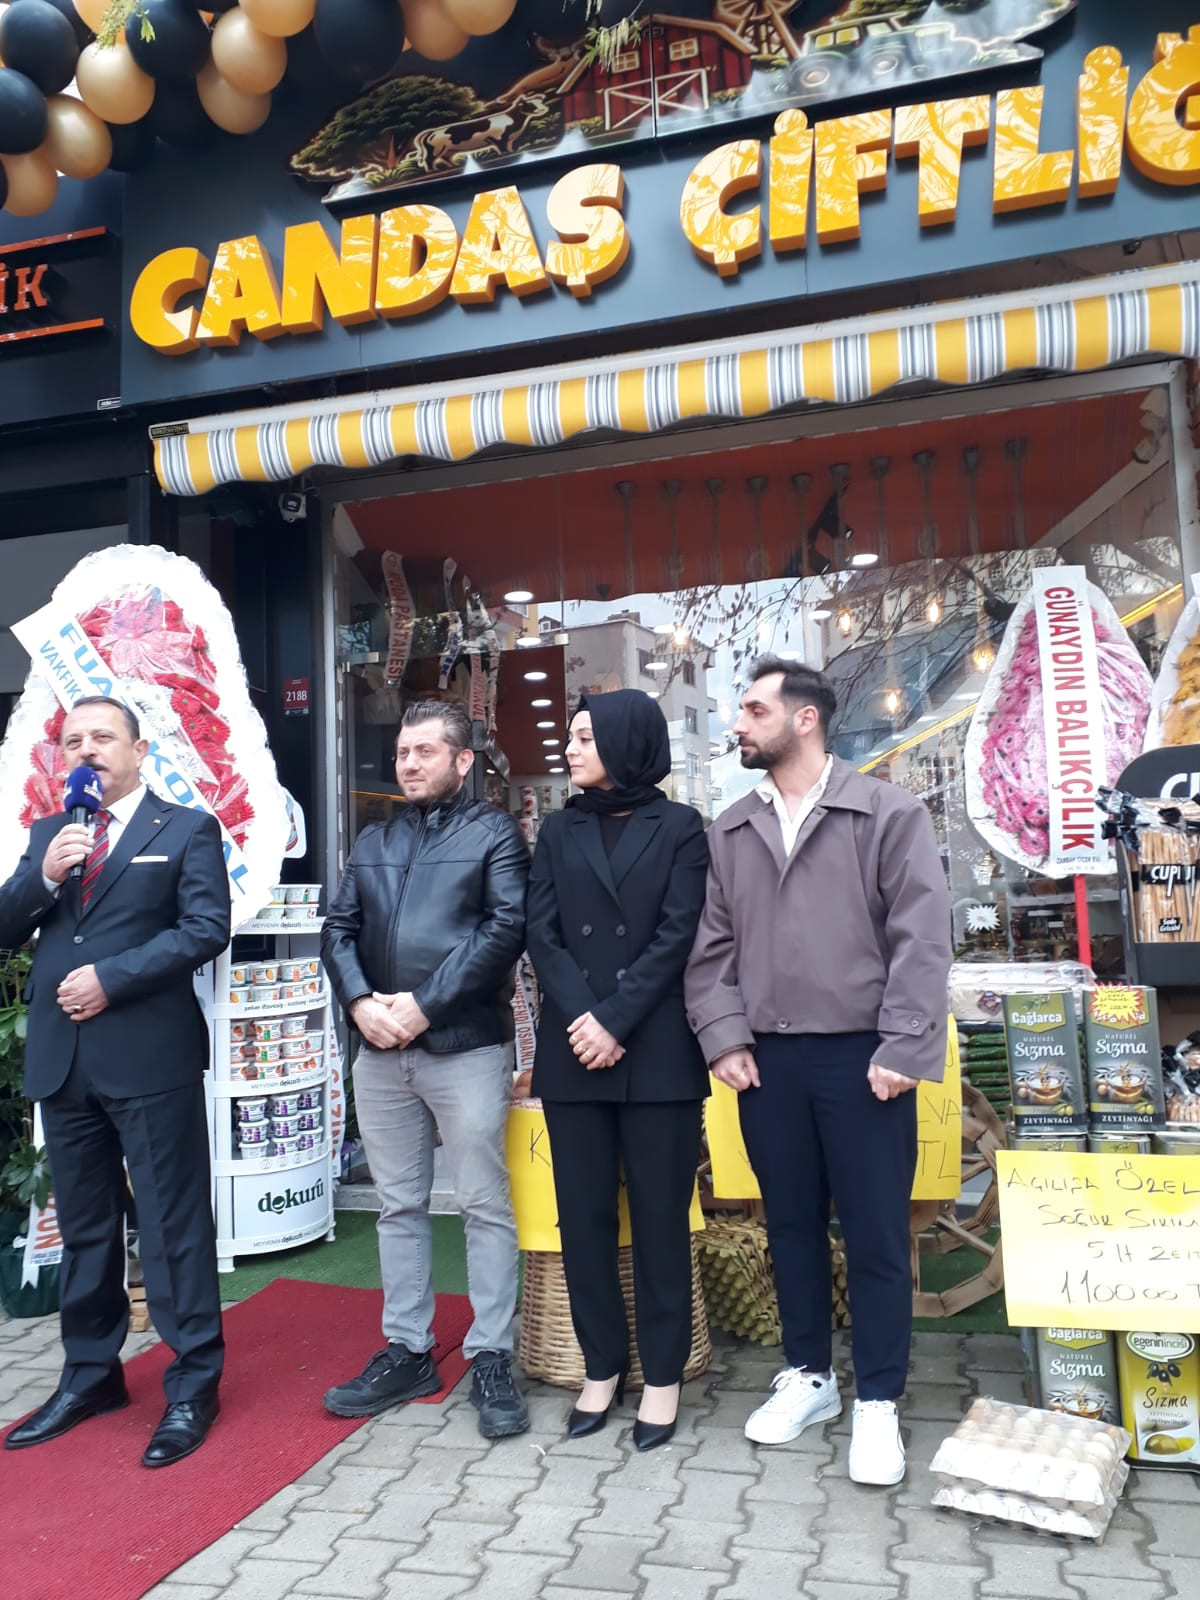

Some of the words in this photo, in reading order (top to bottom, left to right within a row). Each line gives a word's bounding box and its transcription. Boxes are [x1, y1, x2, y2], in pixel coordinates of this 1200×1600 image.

[130, 163, 630, 355] CANDAŞ
[40, 639, 86, 701] VAKFIK
[59, 622, 130, 706] FUA
[1044, 585, 1088, 691] GÜNAYDIN
[148, 740, 248, 895] KOAL
[1051, 699, 1097, 851] BALIKÇILIK
[1088, 1241, 1104, 1259] 5
